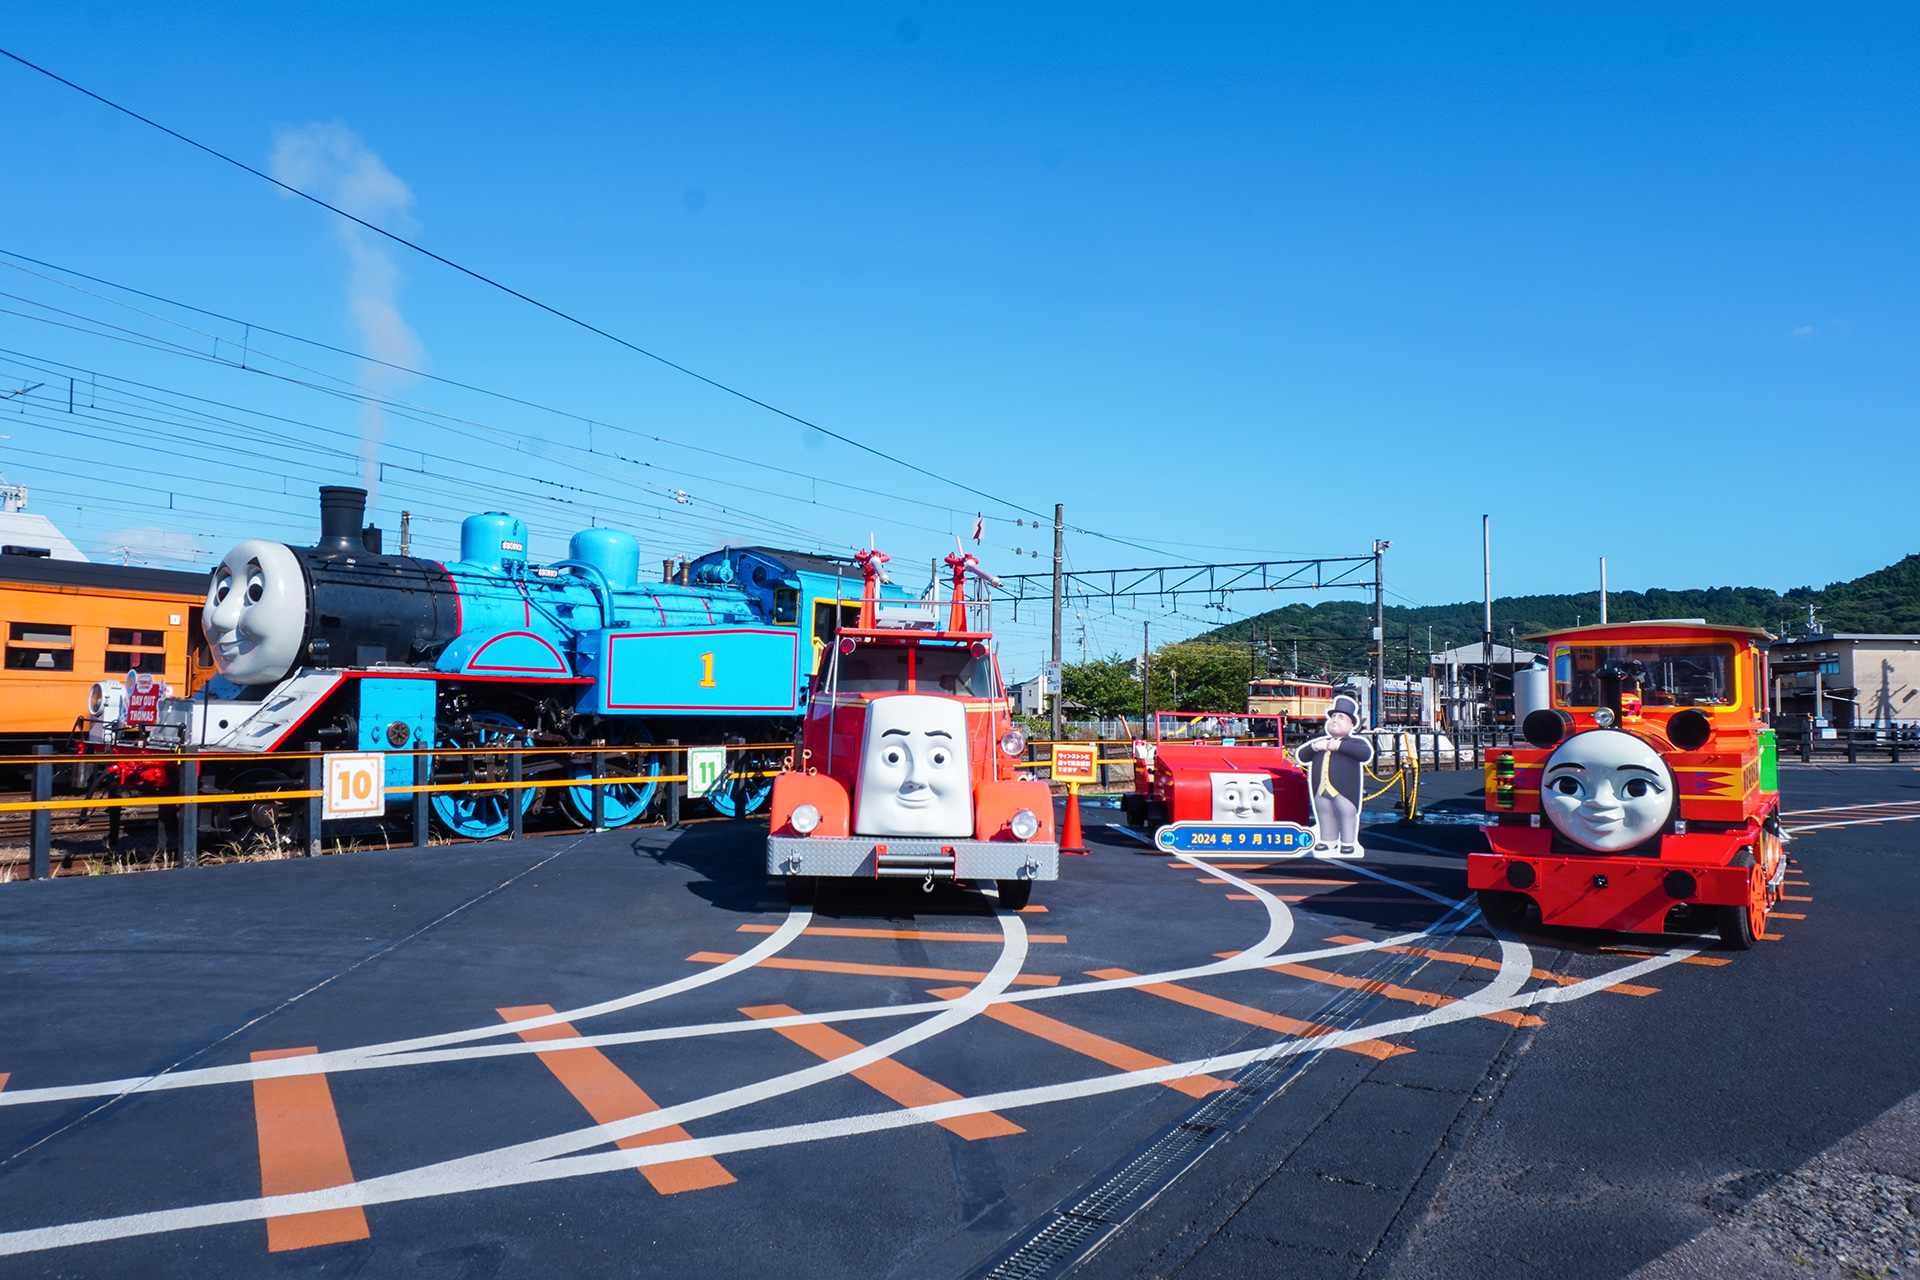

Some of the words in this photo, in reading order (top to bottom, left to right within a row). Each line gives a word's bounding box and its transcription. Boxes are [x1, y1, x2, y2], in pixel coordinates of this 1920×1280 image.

[699, 652, 716, 688] 1
[131, 695, 143, 706] DAY
[143, 695, 156, 706] OUT
[130, 710, 154, 721] THOMAS
[699, 761, 716, 786] 11
[338, 770, 372, 800] 10
[1191, 833, 1217, 844] 2024
